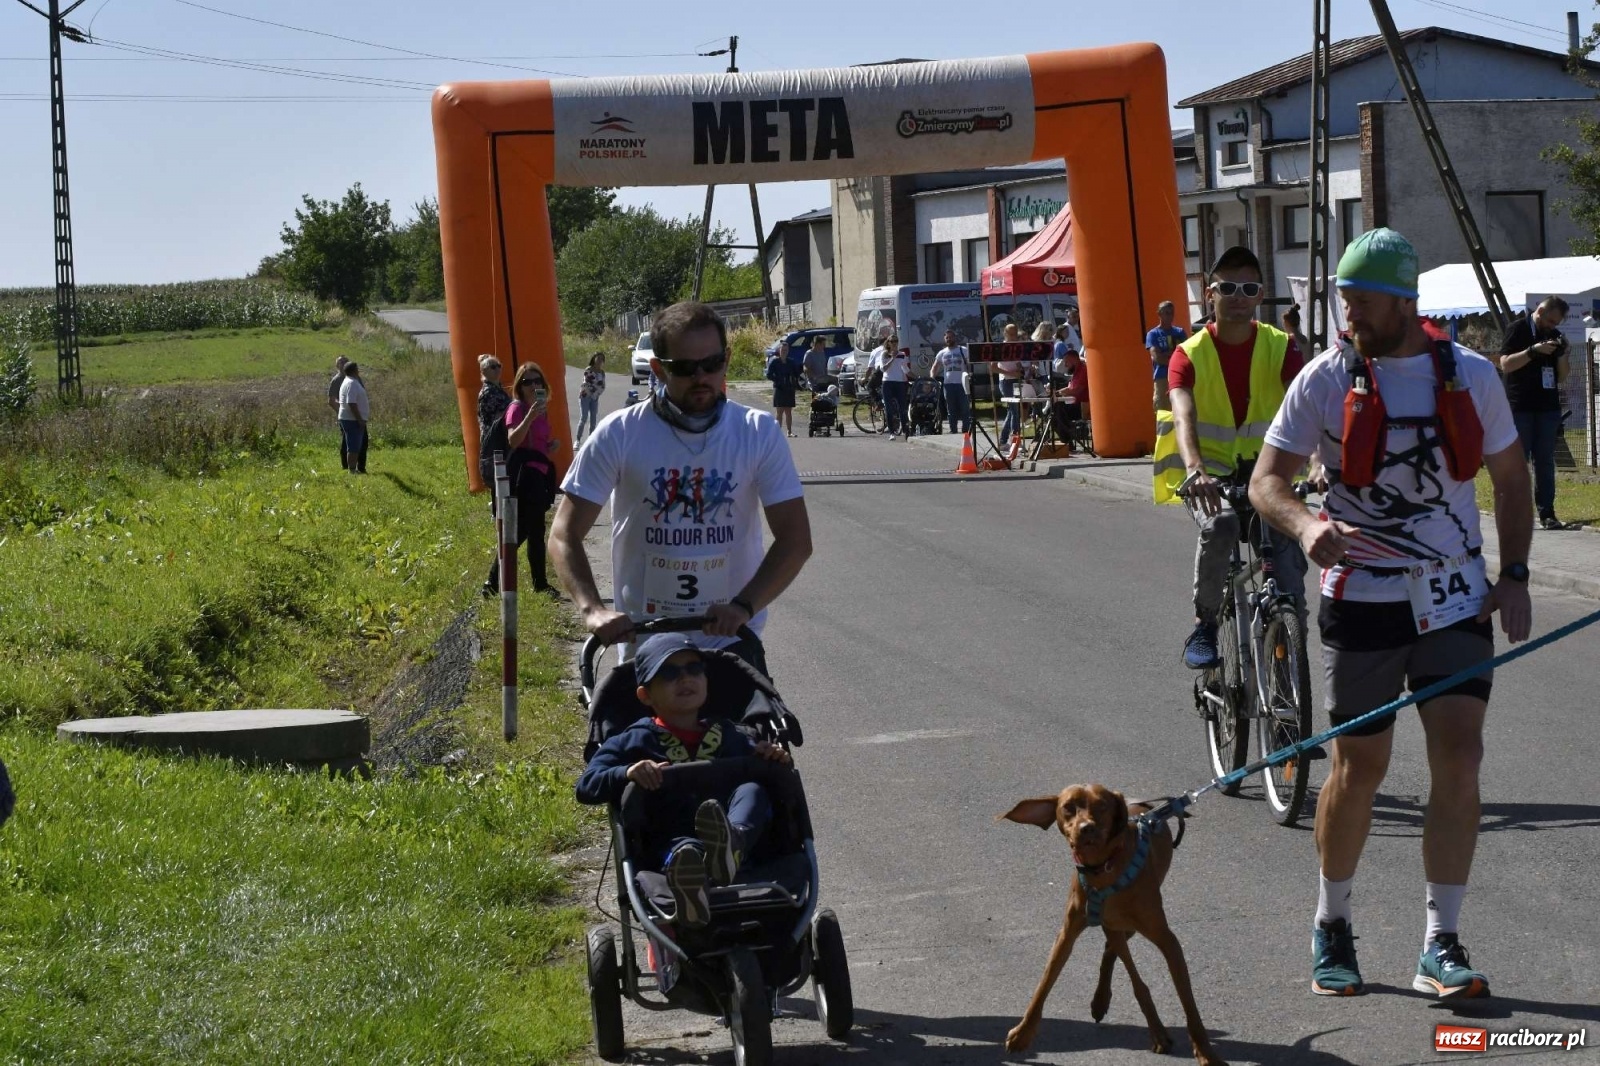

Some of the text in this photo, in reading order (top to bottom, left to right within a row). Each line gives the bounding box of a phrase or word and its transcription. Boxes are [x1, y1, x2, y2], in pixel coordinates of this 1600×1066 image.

[964, 106, 985, 114] pomiar
[692, 97, 854, 165] META
[580, 138, 646, 149] MARATONY
[580, 149, 647, 159] POLSKIE.PL
[1060, 275, 1077, 284] Zm
[646, 525, 734, 546] COLOUR RUN
[652, 557, 725, 572] COLOUR RUN
[676, 574, 699, 600] 3
[1429, 572, 1471, 605] 54
